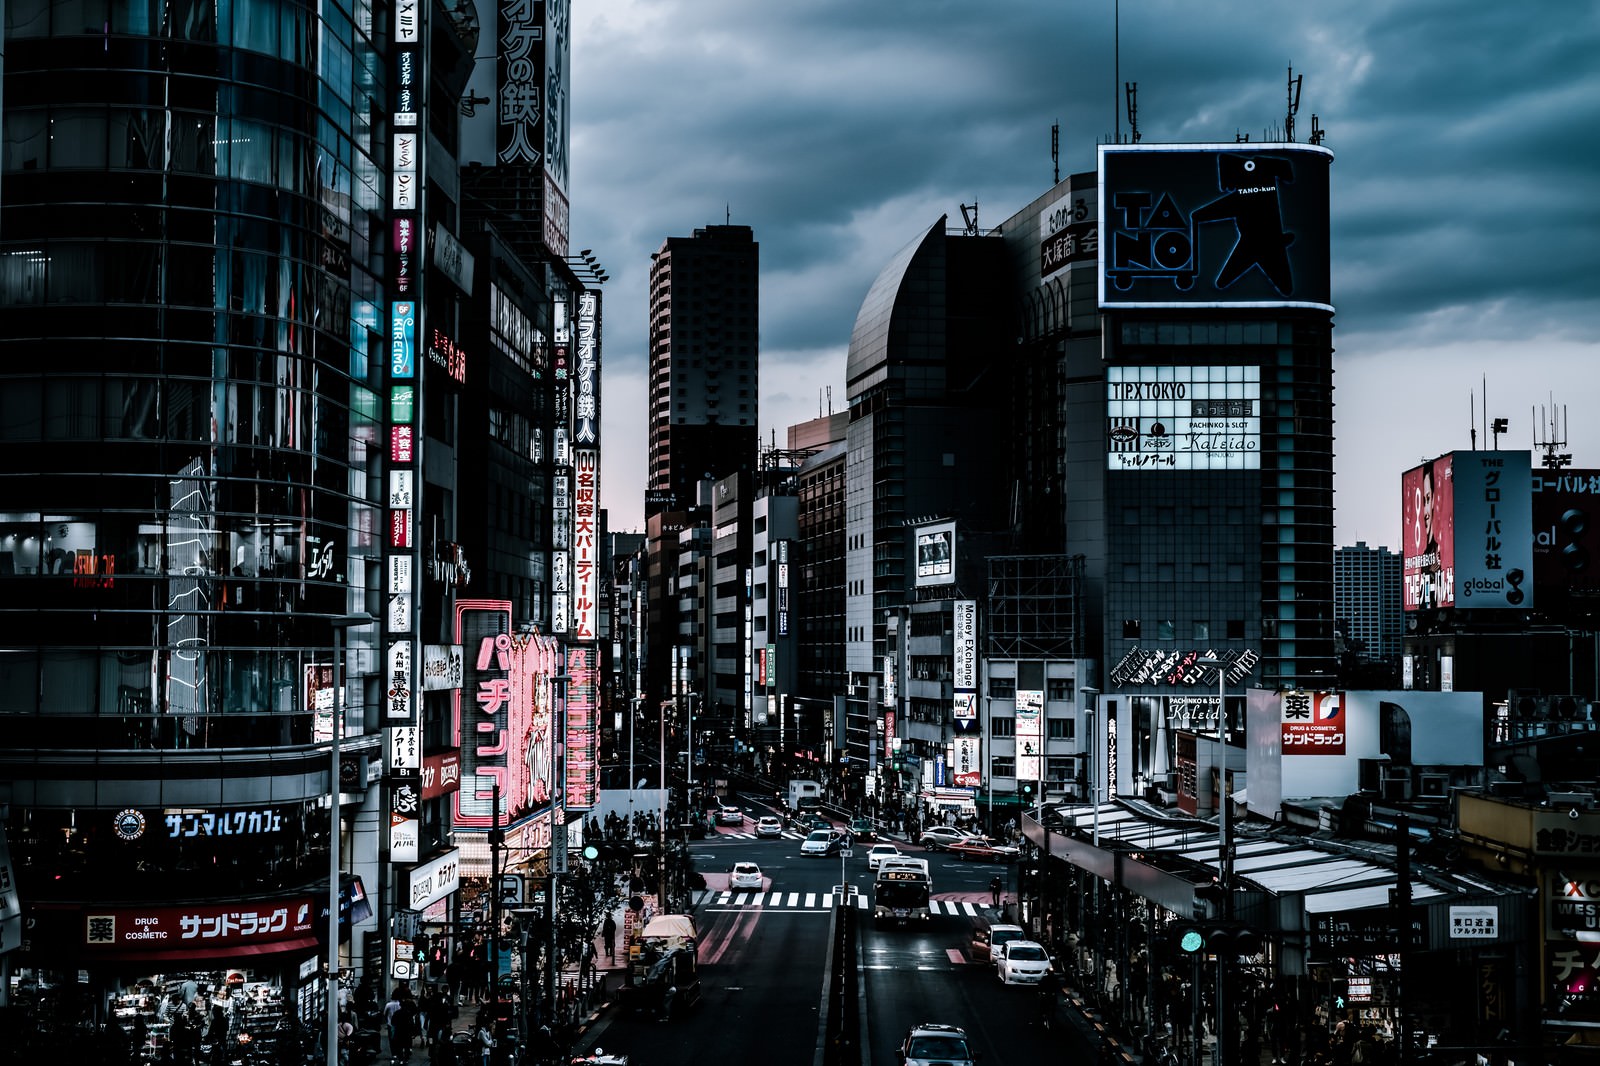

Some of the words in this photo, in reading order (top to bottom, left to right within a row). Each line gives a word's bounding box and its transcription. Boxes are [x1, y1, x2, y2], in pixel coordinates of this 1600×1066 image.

[400, 0, 414, 38] メミヤ
[1042, 227, 1098, 269] 大塚商会
[393, 318, 403, 374] KIREIMO
[576, 291, 597, 443] カラオケの鉄人
[1144, 382, 1186, 400] TOKYO
[398, 426, 410, 461] 美容室
[1143, 440, 1172, 449] バーミヤン
[1181, 431, 1256, 451] Kaleido
[1481, 459, 1504, 467] THE
[1485, 471, 1502, 570] グローバル社
[577, 451, 594, 637] 100名収容大パーティールーム
[1532, 525, 1556, 546] al
[1464, 577, 1504, 597] global
[965, 604, 974, 636] Money
[965, 639, 974, 687] EXchange
[476, 633, 511, 800] パチンコ
[1285, 695, 1310, 719] 薬
[1282, 733, 1344, 745] サンドラッグ
[400, 768, 410, 776] B1
[419, 766, 435, 788] ラオケ
[165, 808, 282, 838] サンマルクカフェ
[438, 863, 456, 888] カラオケ
[134, 917, 159, 925] DRUG
[1557, 903, 1600, 916] WES
[88, 916, 114, 942] 薬
[179, 908, 288, 939] サンドラッグ
[1454, 918, 1494, 927] 東口近道
[125, 931, 168, 940] COSMETIC
[1552, 949, 1600, 982] チ
[1480, 962, 1497, 1021] チケット
